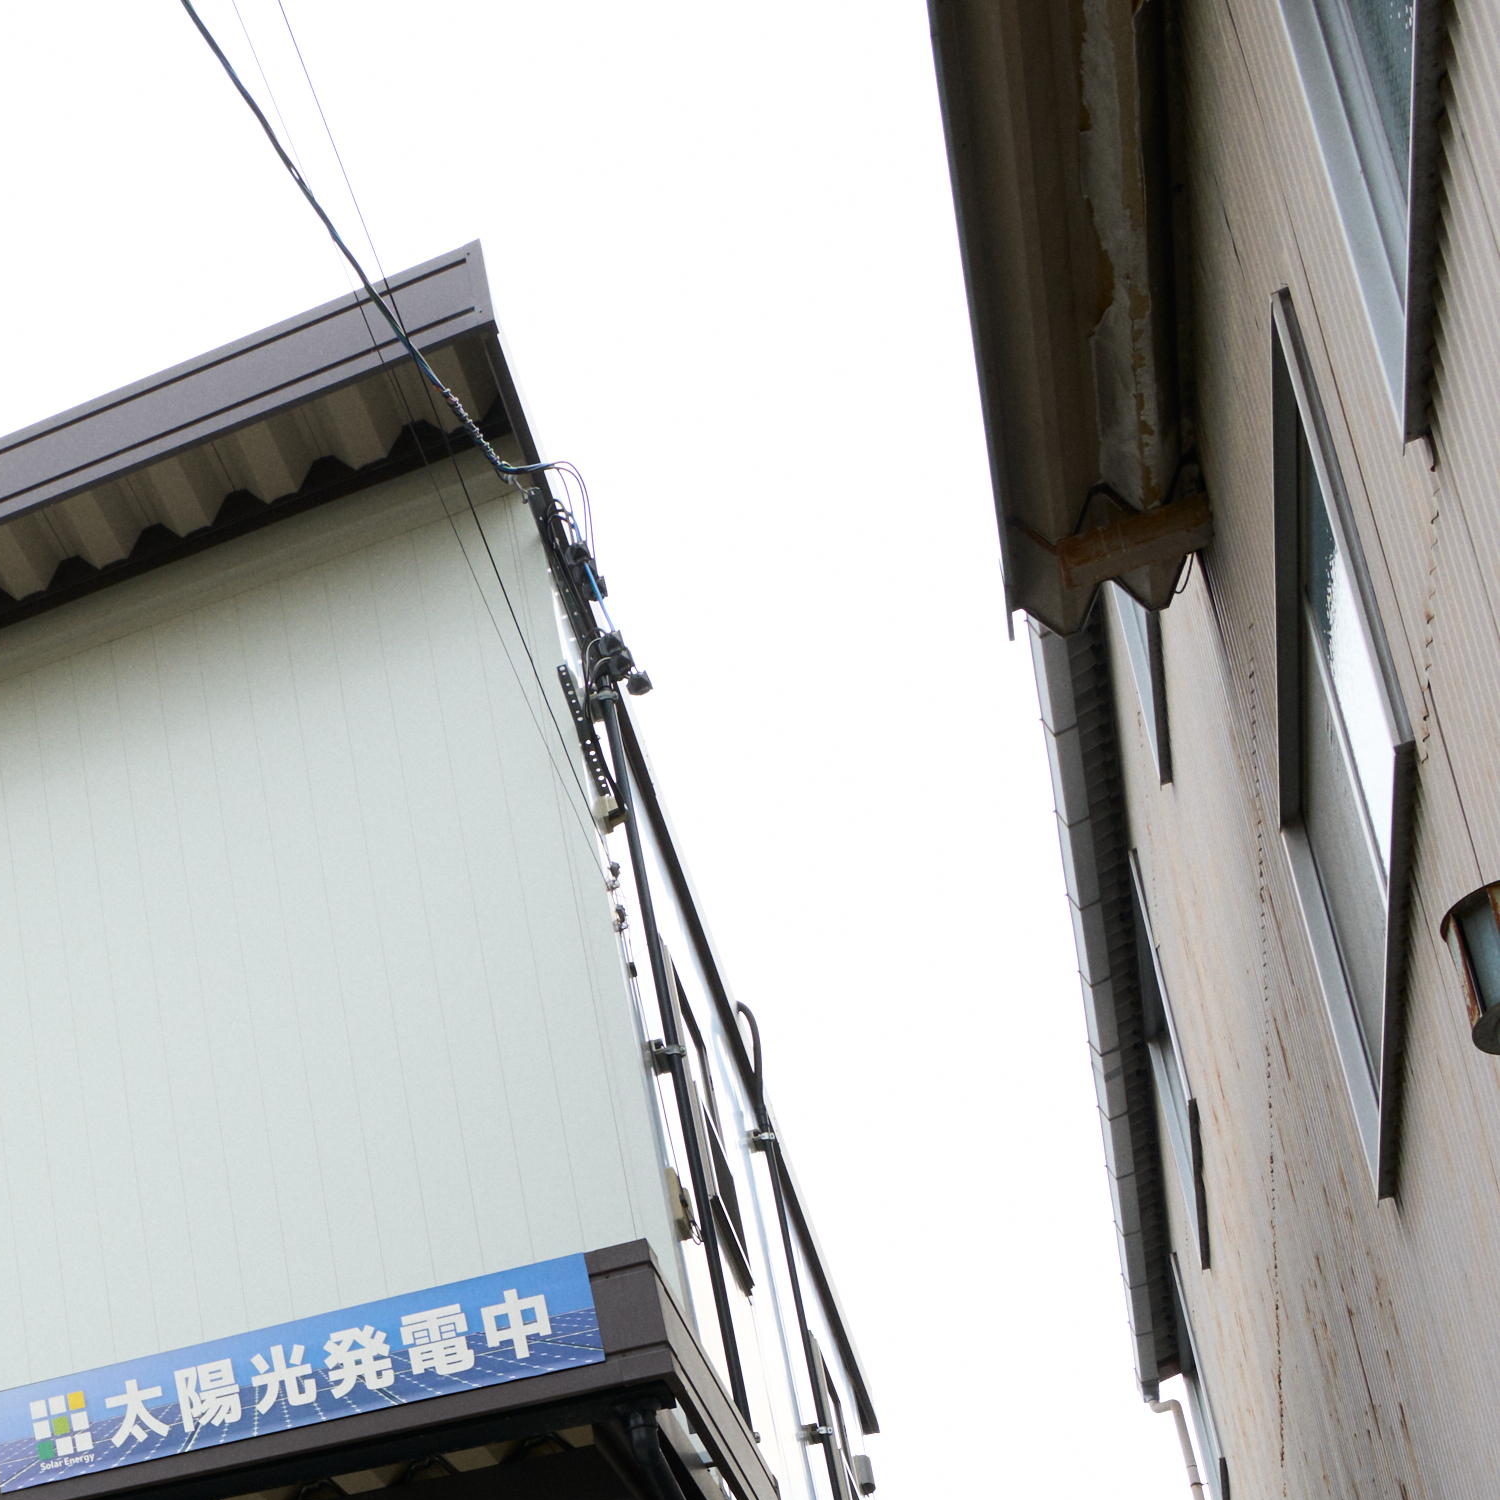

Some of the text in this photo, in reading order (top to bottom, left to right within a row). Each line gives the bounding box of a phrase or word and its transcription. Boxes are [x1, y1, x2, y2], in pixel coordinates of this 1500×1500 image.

[105, 1287, 552, 1453] 太陽光発電中
[40, 1453, 95, 1471] Solar Energy
